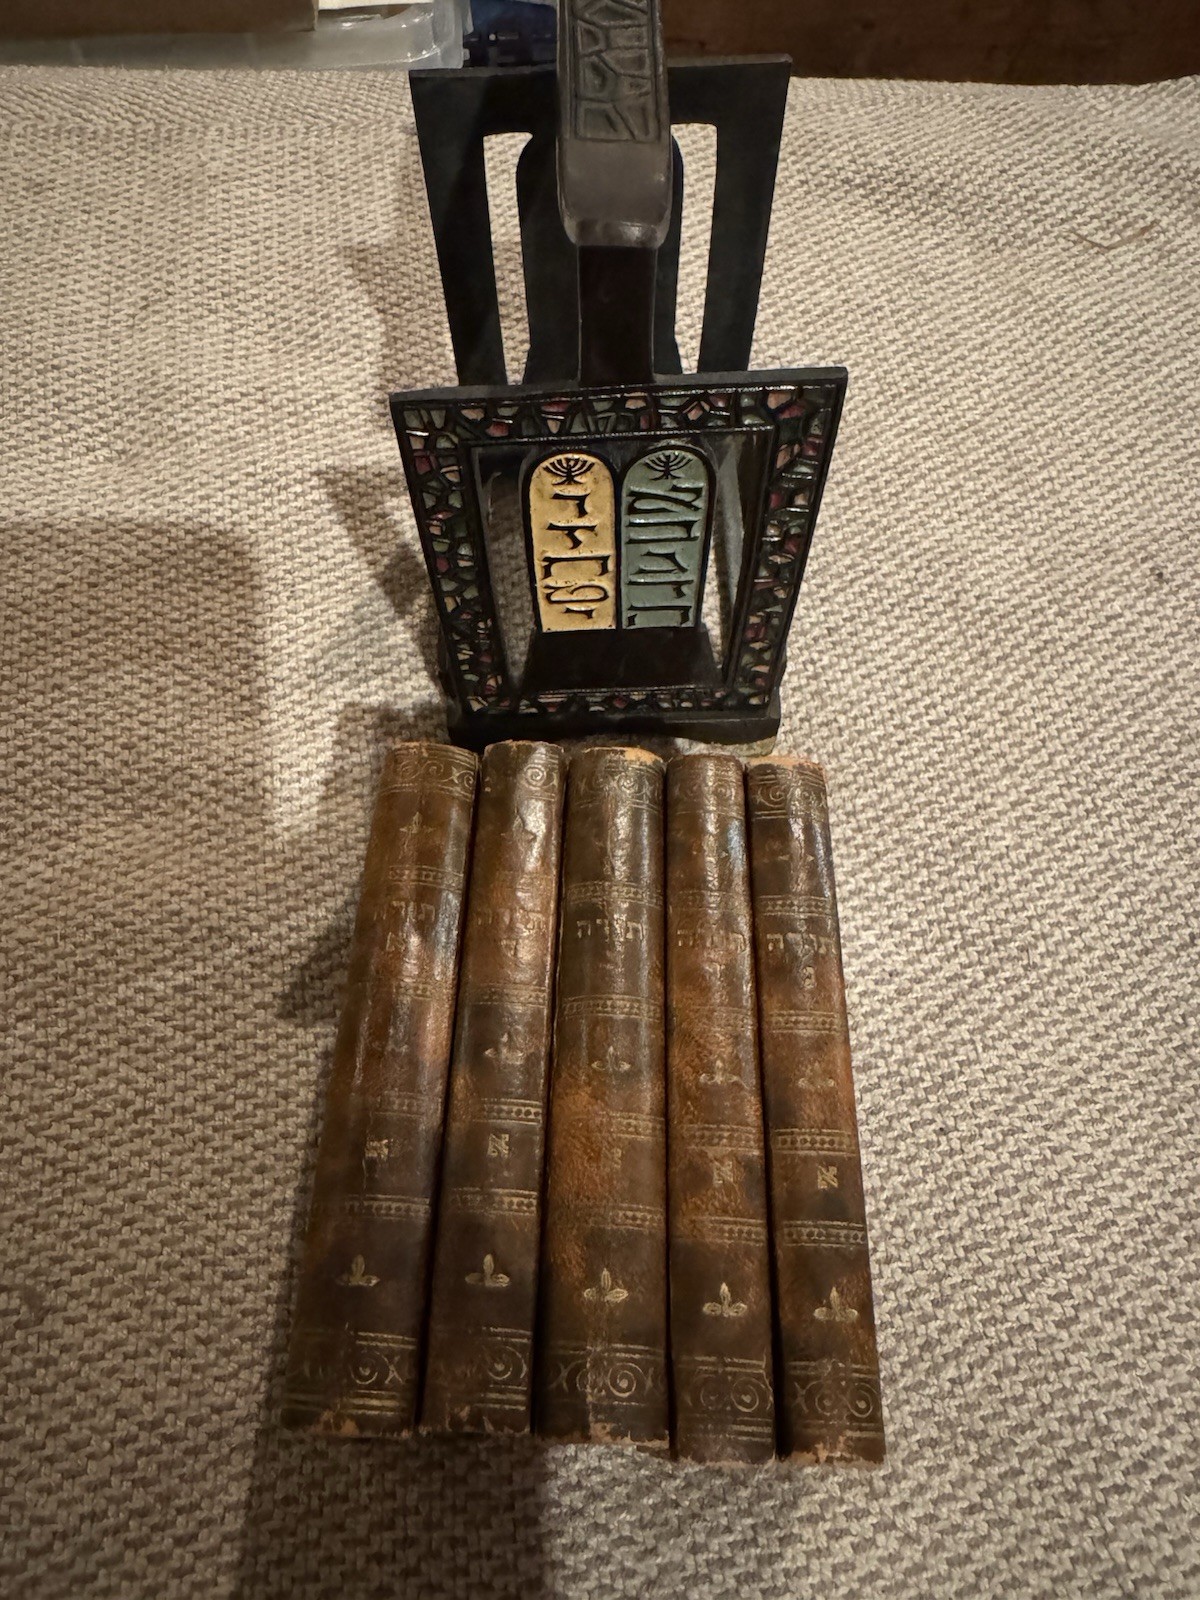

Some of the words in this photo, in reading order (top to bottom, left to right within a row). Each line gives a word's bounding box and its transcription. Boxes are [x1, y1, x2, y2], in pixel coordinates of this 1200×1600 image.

[552, 492, 591, 518] ו
[629, 486, 703, 514] א
[547, 524, 600, 549] ז
[626, 519, 700, 545] ב
[542, 555, 611, 580] ח
[637, 550, 688, 573] ג
[543, 584, 610, 604] ט
[627, 580, 694, 600] ד
[564, 608, 597, 620] י
[627, 605, 692, 628] ה
